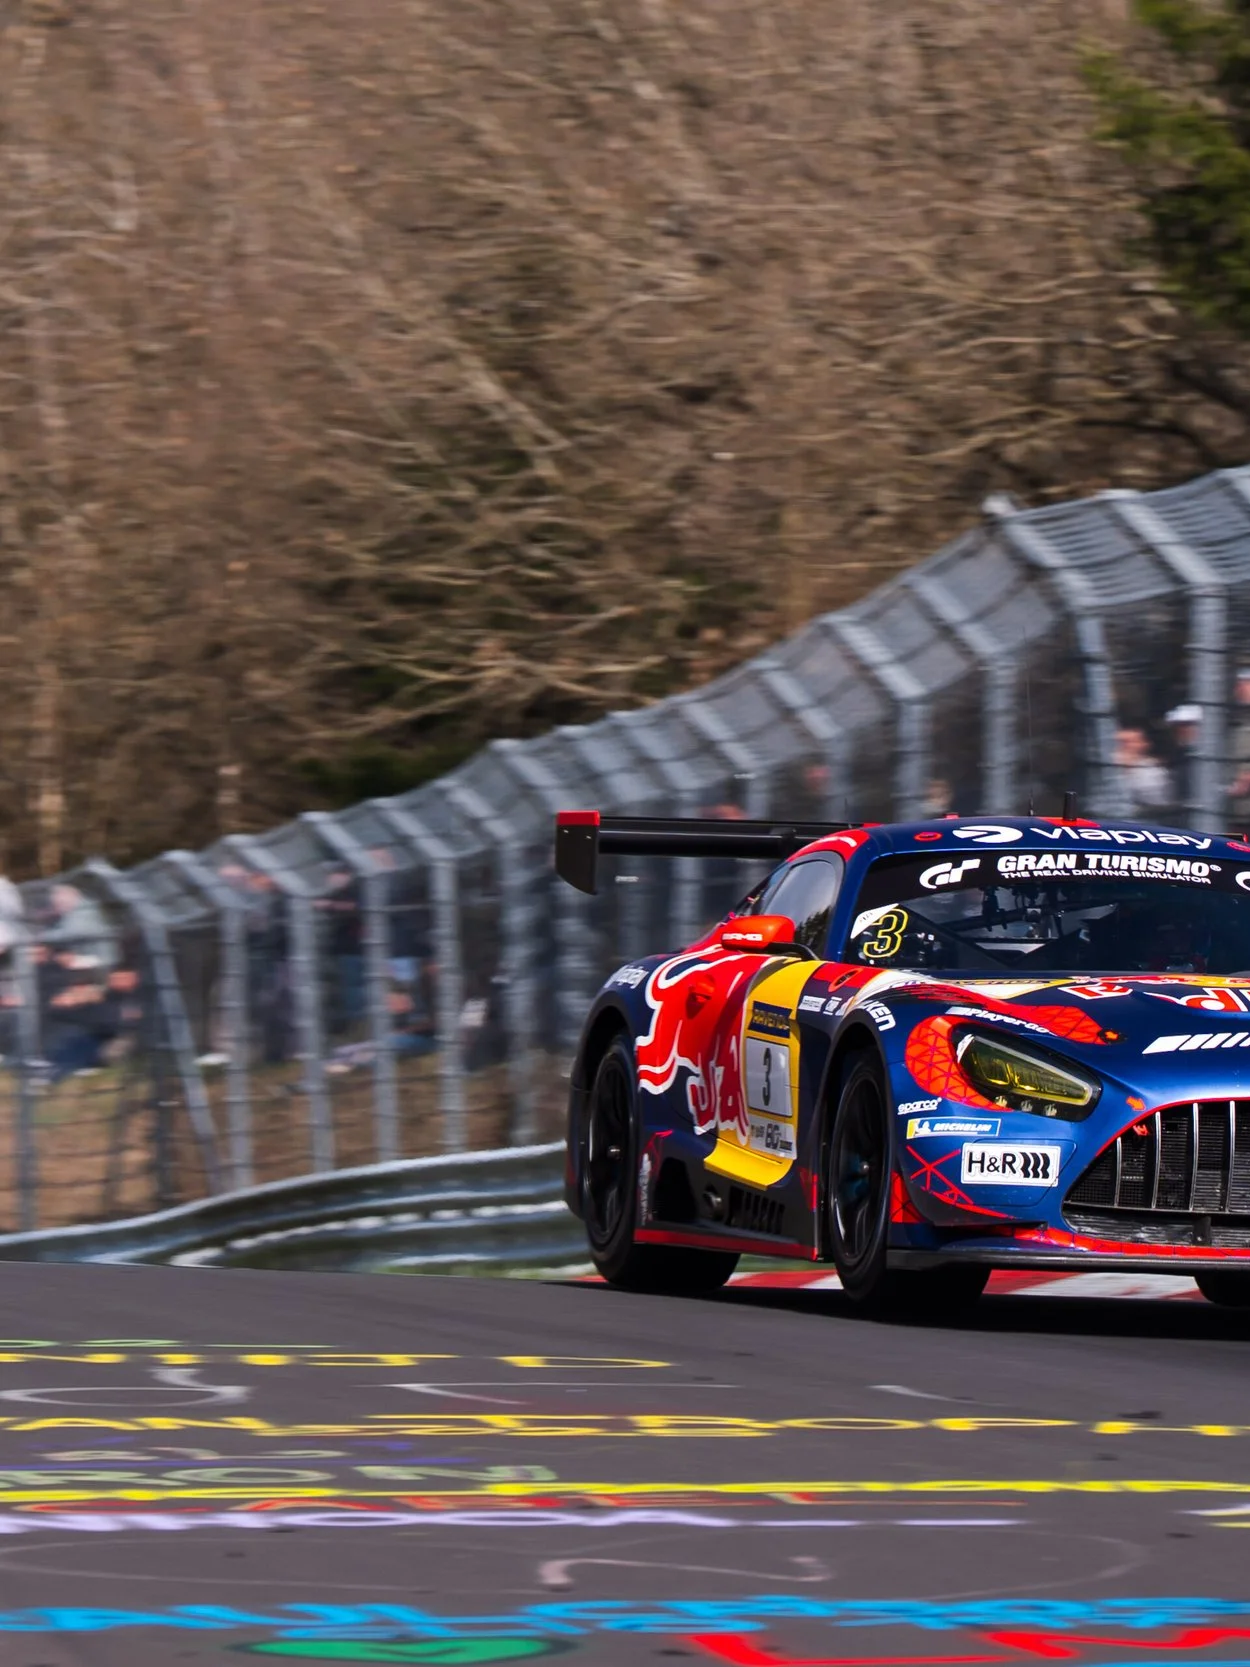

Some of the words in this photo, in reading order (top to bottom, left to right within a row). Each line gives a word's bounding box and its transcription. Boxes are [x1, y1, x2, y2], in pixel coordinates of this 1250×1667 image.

[919, 859, 981, 889] GT
[997, 854, 1078, 872] GRAN
[1036, 869, 1067, 877] REAL
[1069, 869, 1128, 877] DRIVING
[1130, 870, 1211, 884] SIMULATOR
[863, 909, 908, 958] 3
[761, 1047, 772, 1106] 3
[933, 1122, 992, 1132] MICHELIN
[967, 1151, 1017, 1174] H&R
